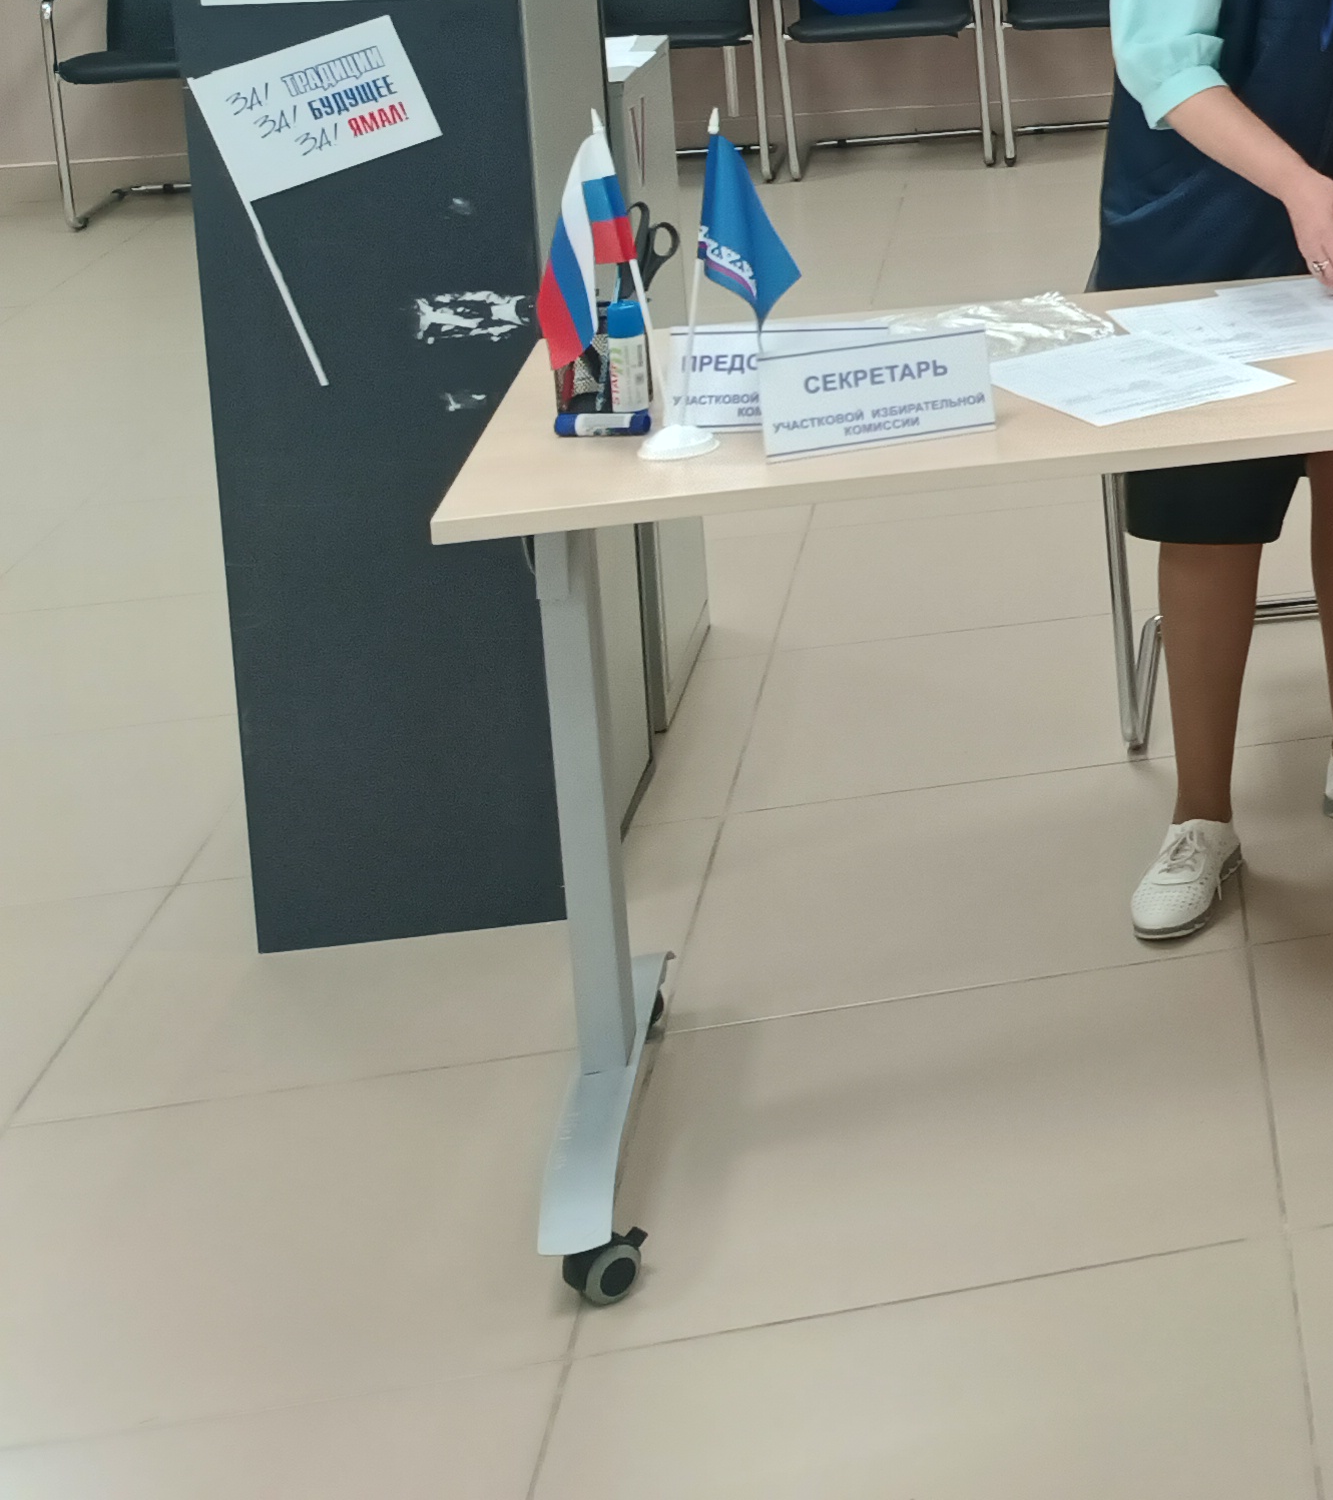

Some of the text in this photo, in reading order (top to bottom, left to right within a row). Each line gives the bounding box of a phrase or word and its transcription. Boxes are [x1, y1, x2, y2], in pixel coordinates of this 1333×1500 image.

[225, 45, 386, 116] ЗА! ТРАДИЦИИ
[253, 74, 398, 139] ЗА! БУДУЩЕЕ
[294, 101, 410, 156] ЗА! ЯМАЛ!
[803, 359, 949, 394] СЕКРЕТАРЬ
[772, 409, 865, 434] УЧАСТКОВОЙ
[871, 392, 986, 419] ИЗБИРАТЕЛЬНОЙ
[844, 416, 921, 437] КОМИССИИ
